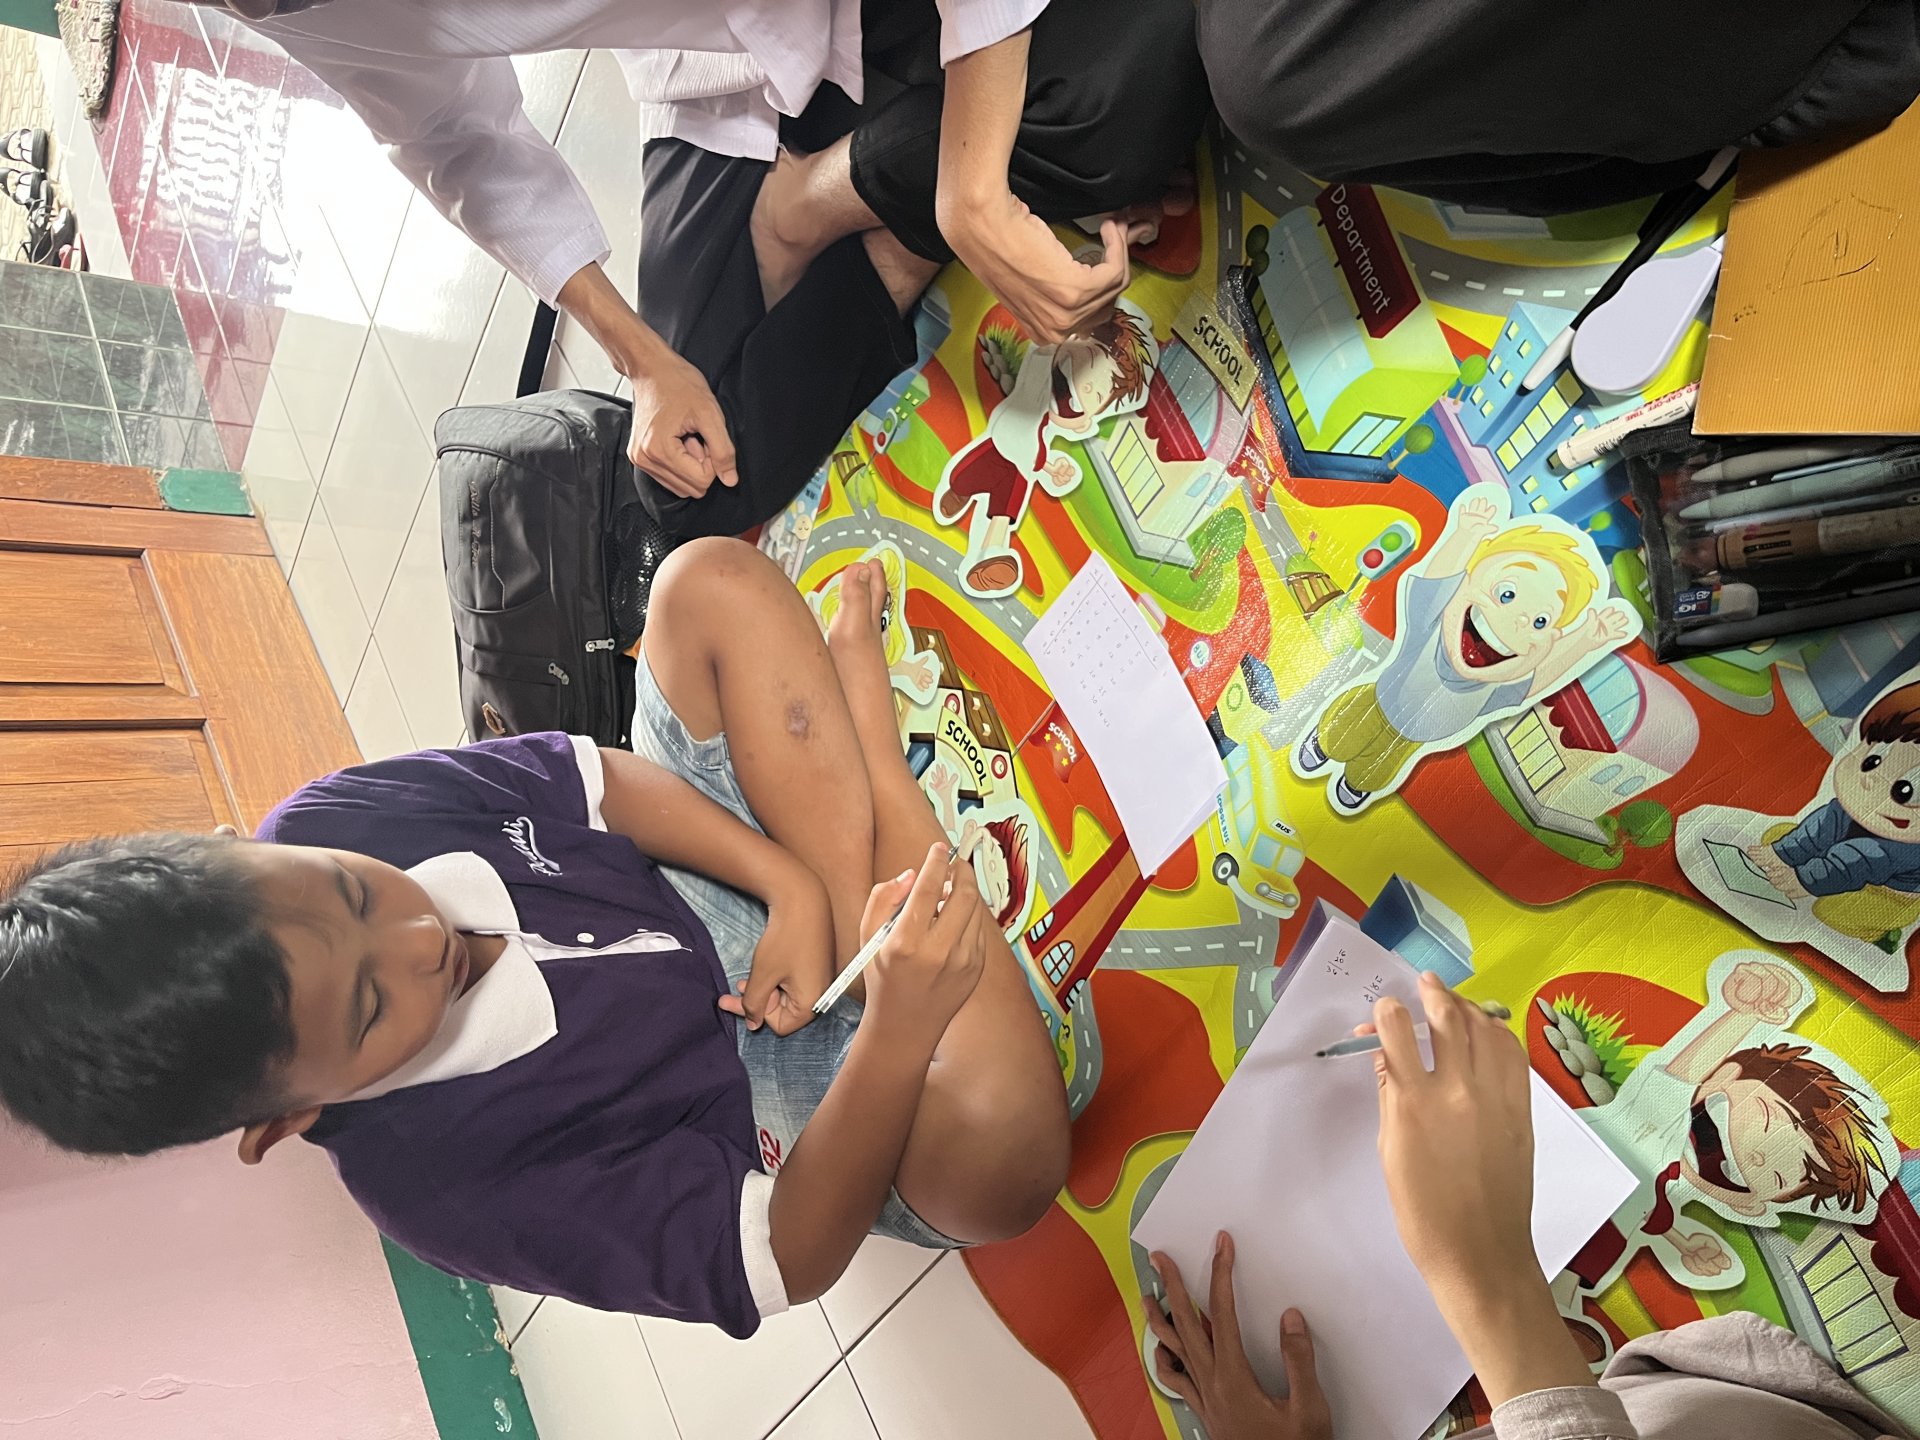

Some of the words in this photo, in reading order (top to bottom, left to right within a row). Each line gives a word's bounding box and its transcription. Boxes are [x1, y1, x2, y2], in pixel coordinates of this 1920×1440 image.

[1330, 183, 1391, 314] Department
[1193, 316, 1243, 386] SCHOOL
[1625, 409, 1645, 422] TIME
[1244, 445, 1271, 487] SCHOOL
[1193, 644, 1206, 665] BUS
[945, 719, 987, 787] SCHOOL
[1048, 722, 1078, 763] SCHOOL
[1222, 825, 1230, 843] BUS
[1275, 822, 1292, 834] BUS
